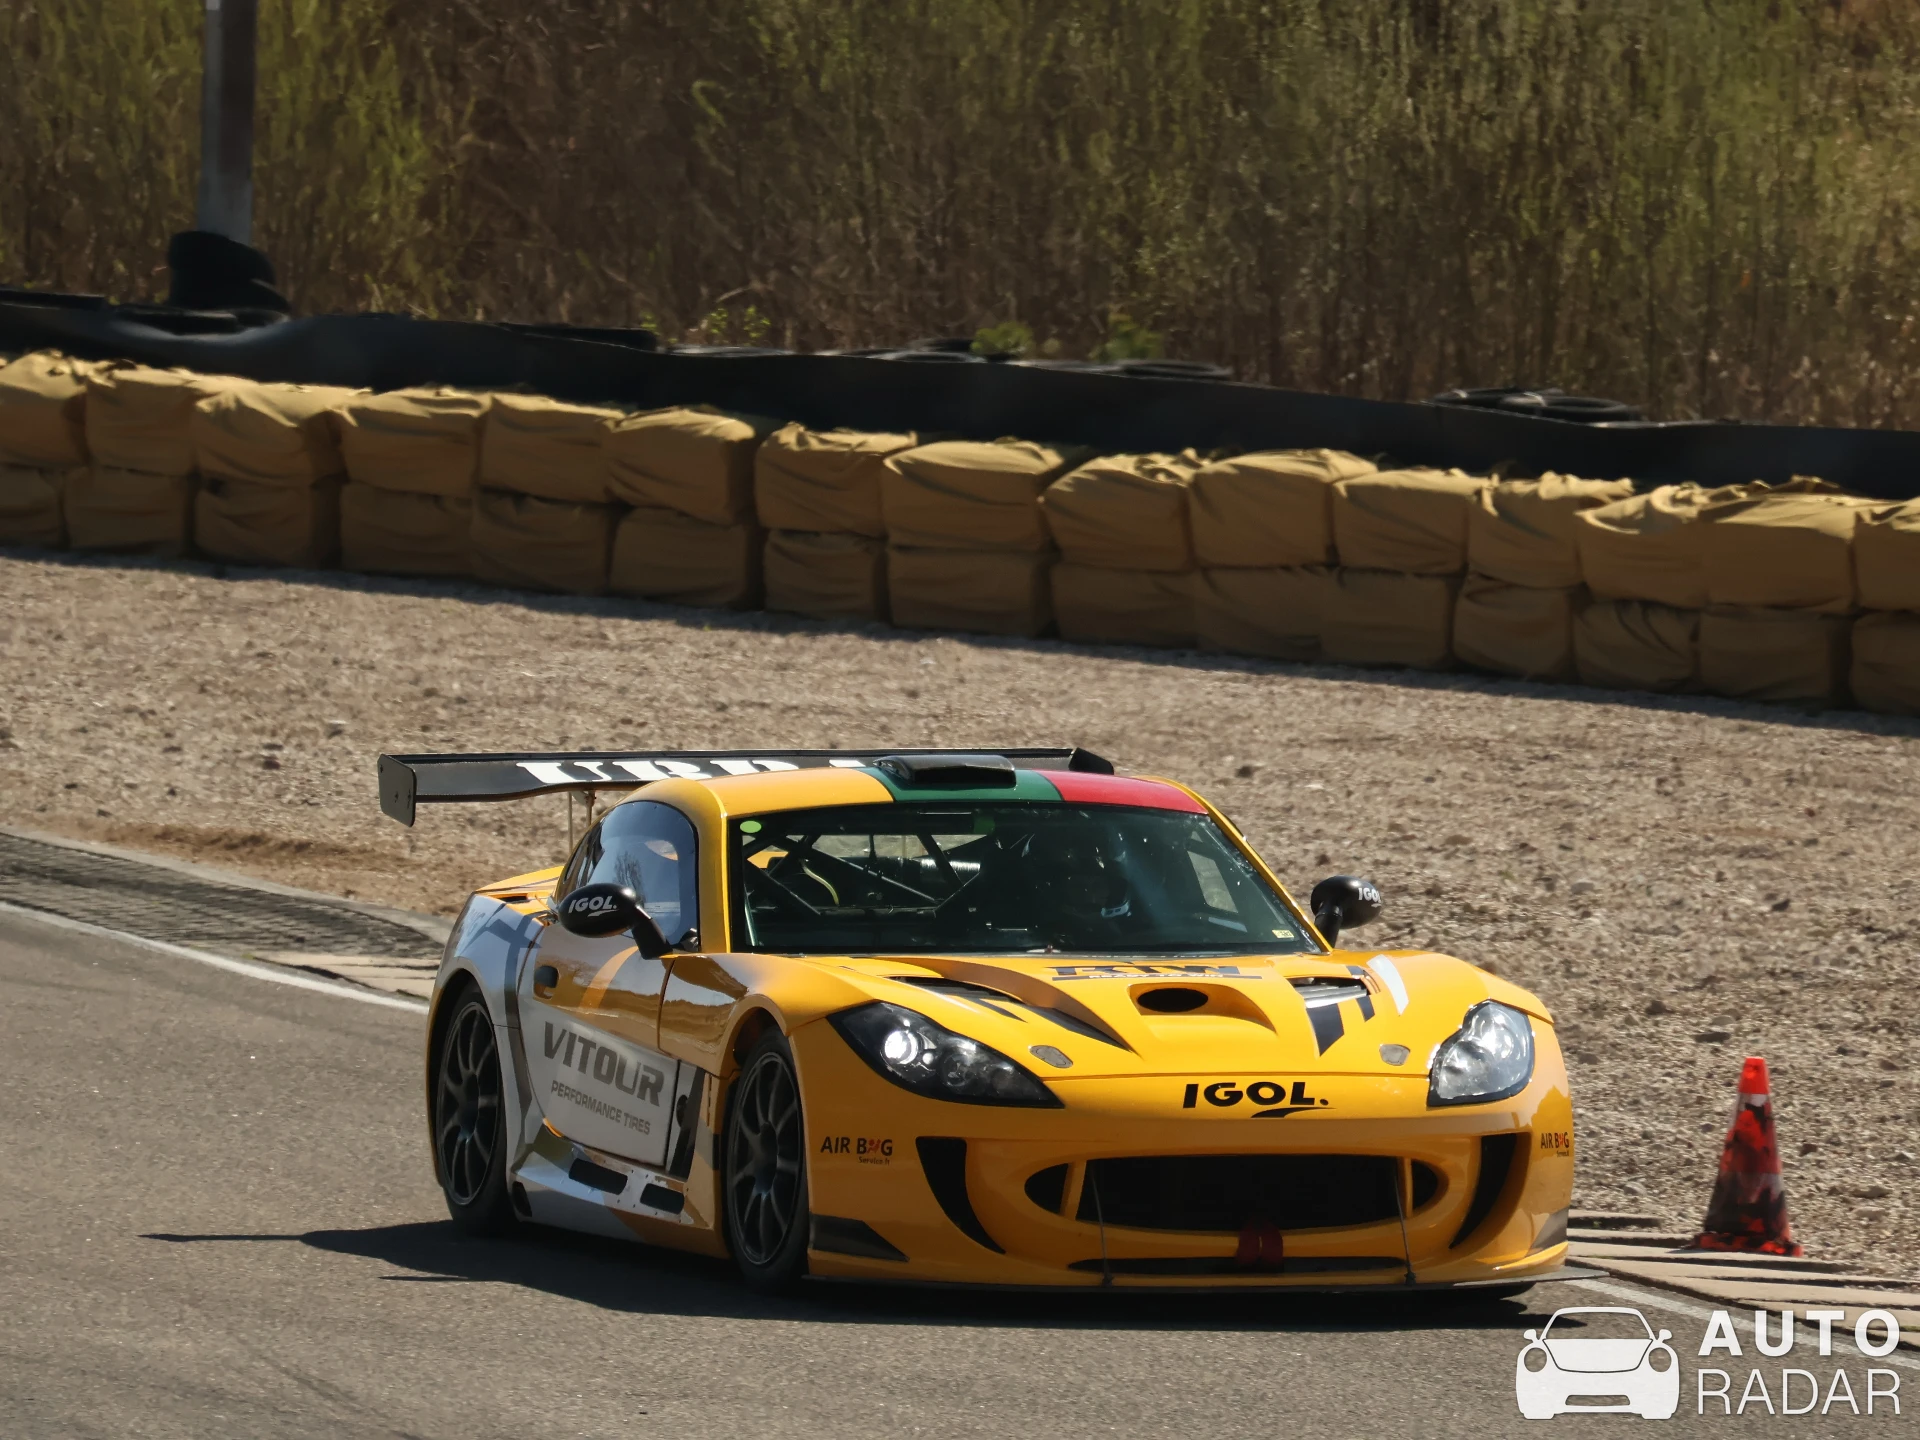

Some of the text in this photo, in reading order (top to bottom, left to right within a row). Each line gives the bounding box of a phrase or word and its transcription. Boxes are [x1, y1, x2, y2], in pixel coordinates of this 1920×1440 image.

[544, 1021, 665, 1107] VITOUR
[551, 1079, 652, 1136] PERFORMANCE TIRES
[820, 1136, 851, 1154] AIR
[1541, 1132, 1553, 1148] AIR
